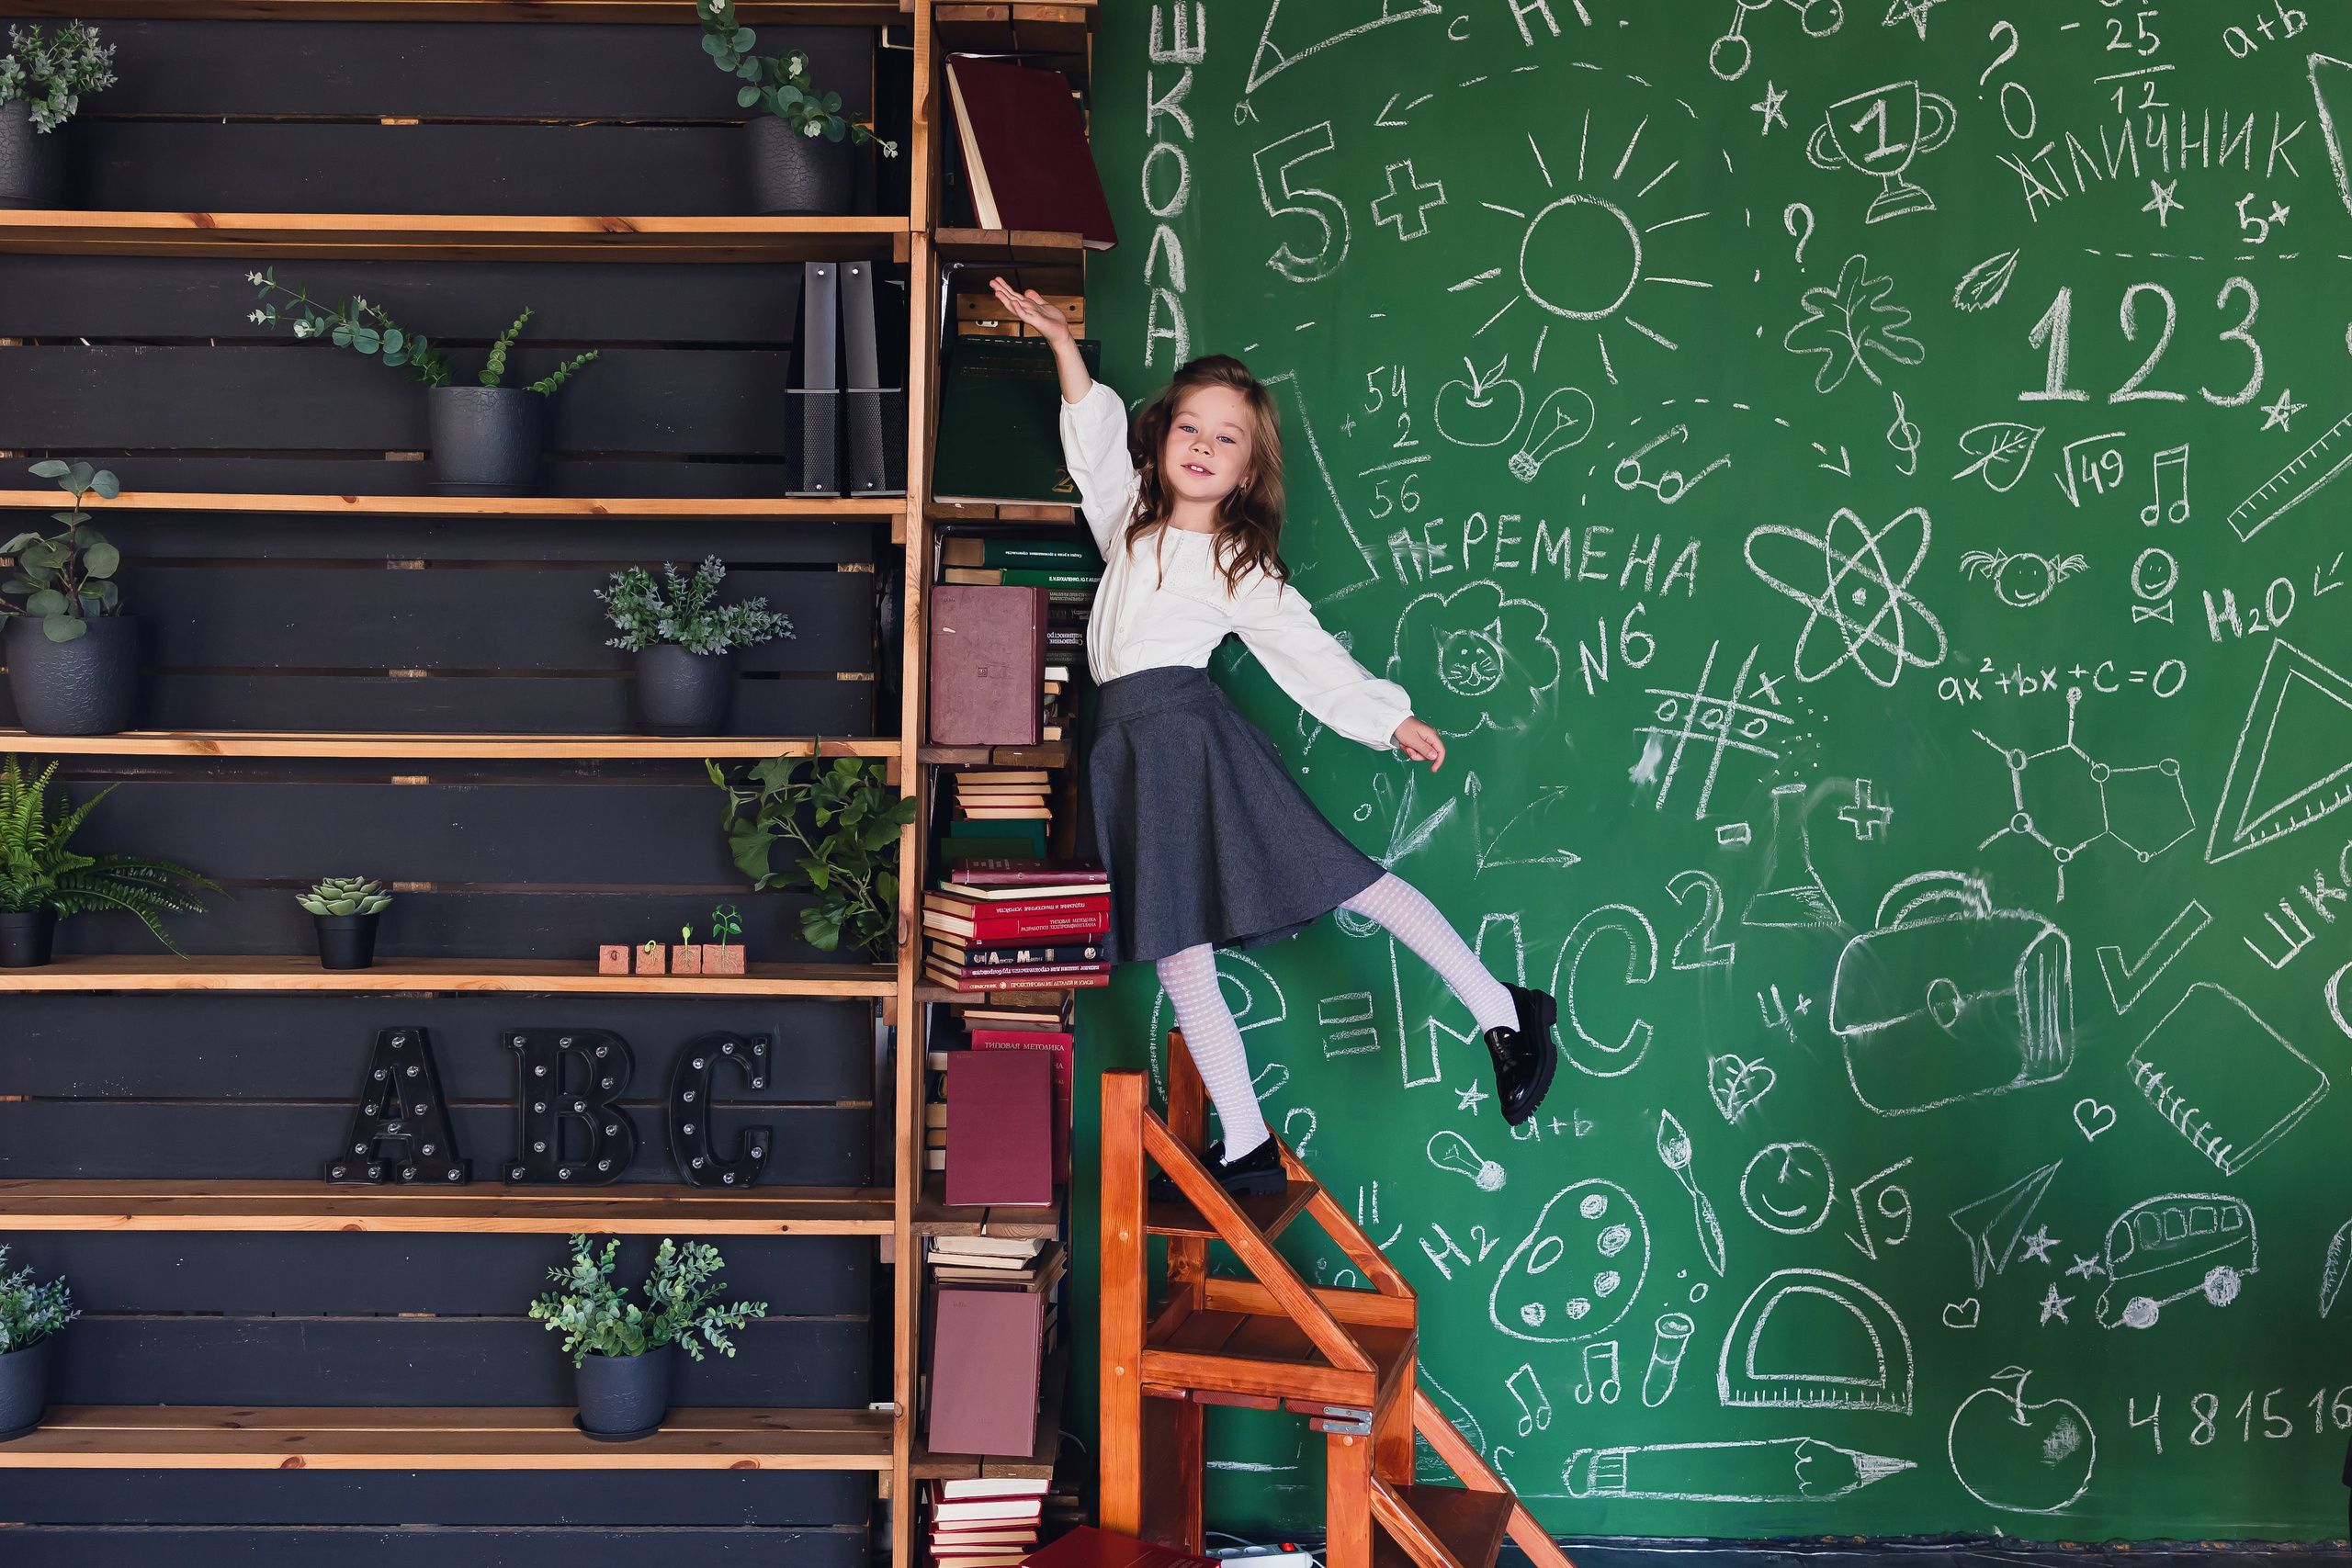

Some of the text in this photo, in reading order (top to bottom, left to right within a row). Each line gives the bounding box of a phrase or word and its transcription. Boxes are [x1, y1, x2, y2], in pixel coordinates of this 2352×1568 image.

[2106, 11, 2162, 56] 25
[1849, 97, 1911, 163] 1
[1142, 0, 1206, 371] ШКОЛА
[1364, 365, 1408, 412] 54
[1367, 472, 1421, 520] 56
[1386, 511, 1702, 599] ПЕРЕМЕНА
[984, 1042, 1065, 1052] ТИПОВАЯ МЕТОДИКА
